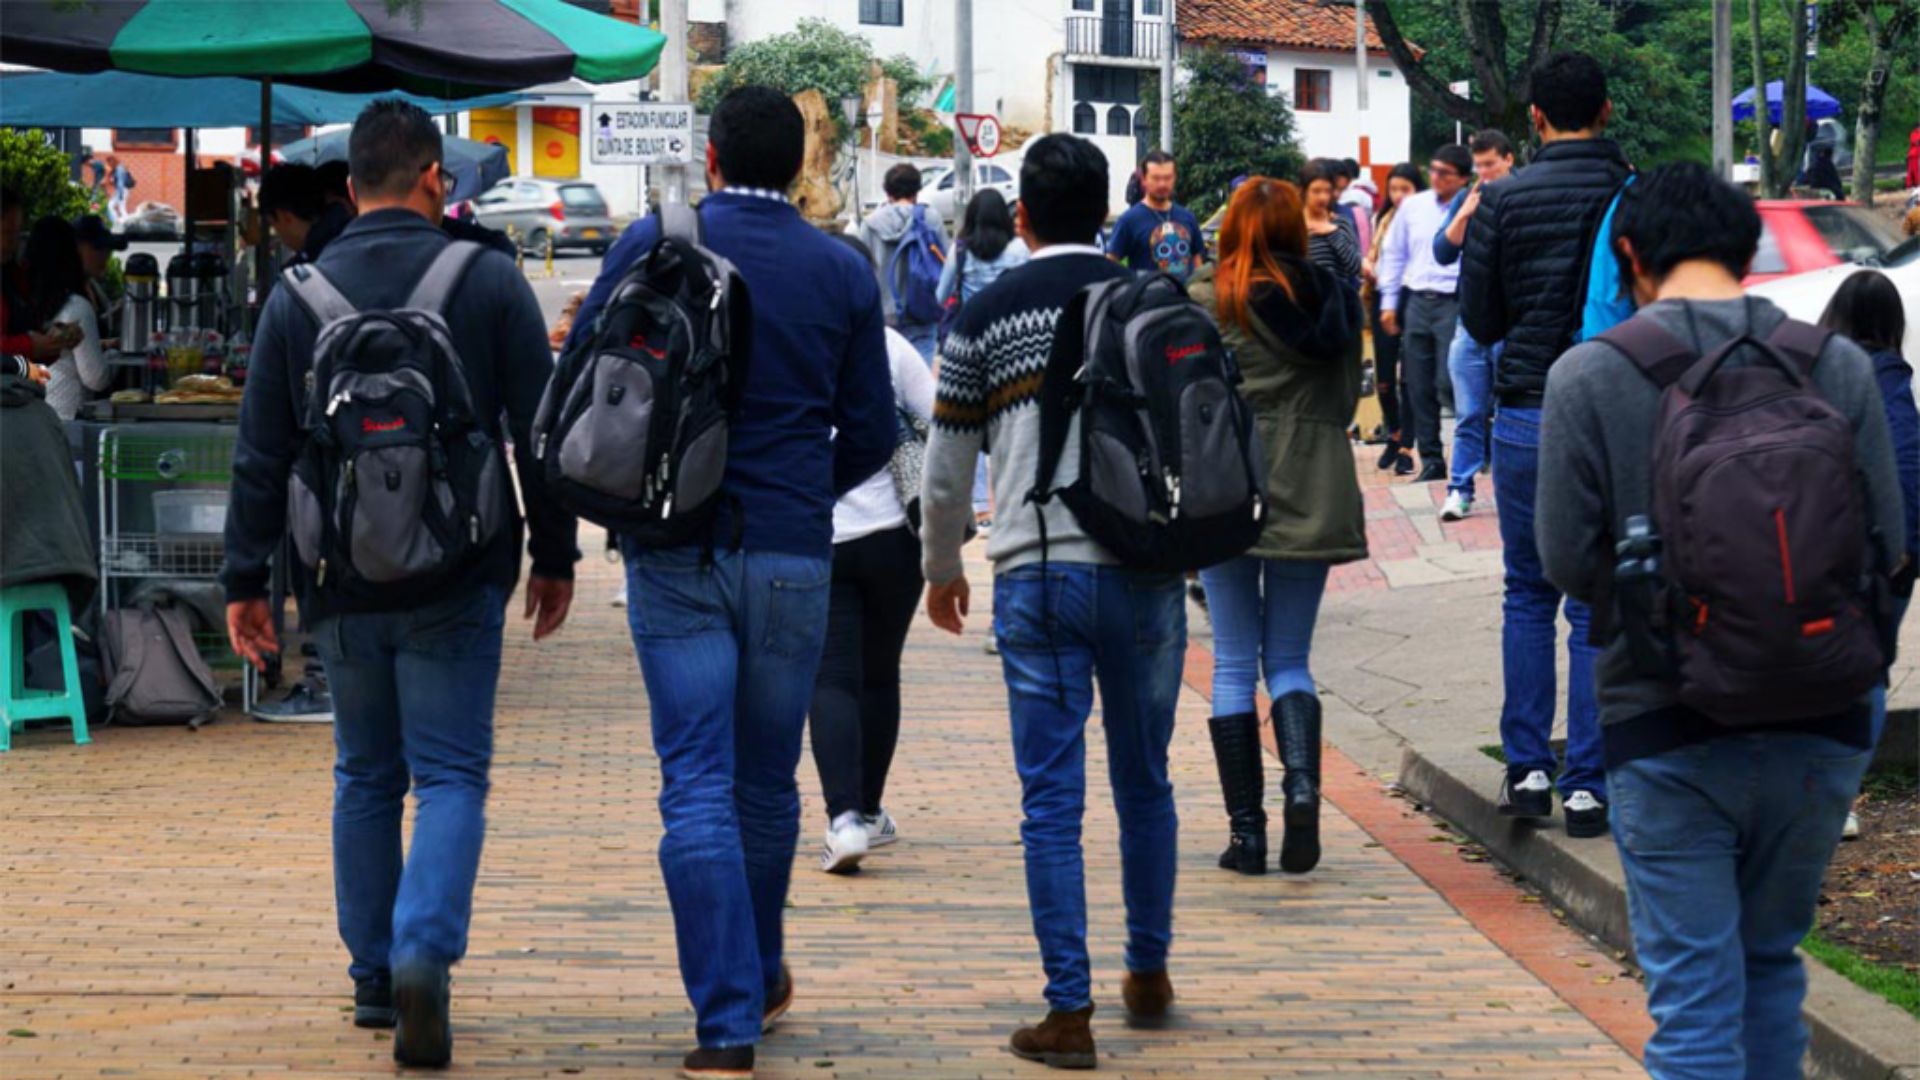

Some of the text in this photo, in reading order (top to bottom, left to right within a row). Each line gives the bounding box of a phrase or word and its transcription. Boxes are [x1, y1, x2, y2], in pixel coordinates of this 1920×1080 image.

[616, 111, 688, 129] ESTACION FUNICULAR
[597, 138, 666, 156] QUINTA DE BOLIVAR
